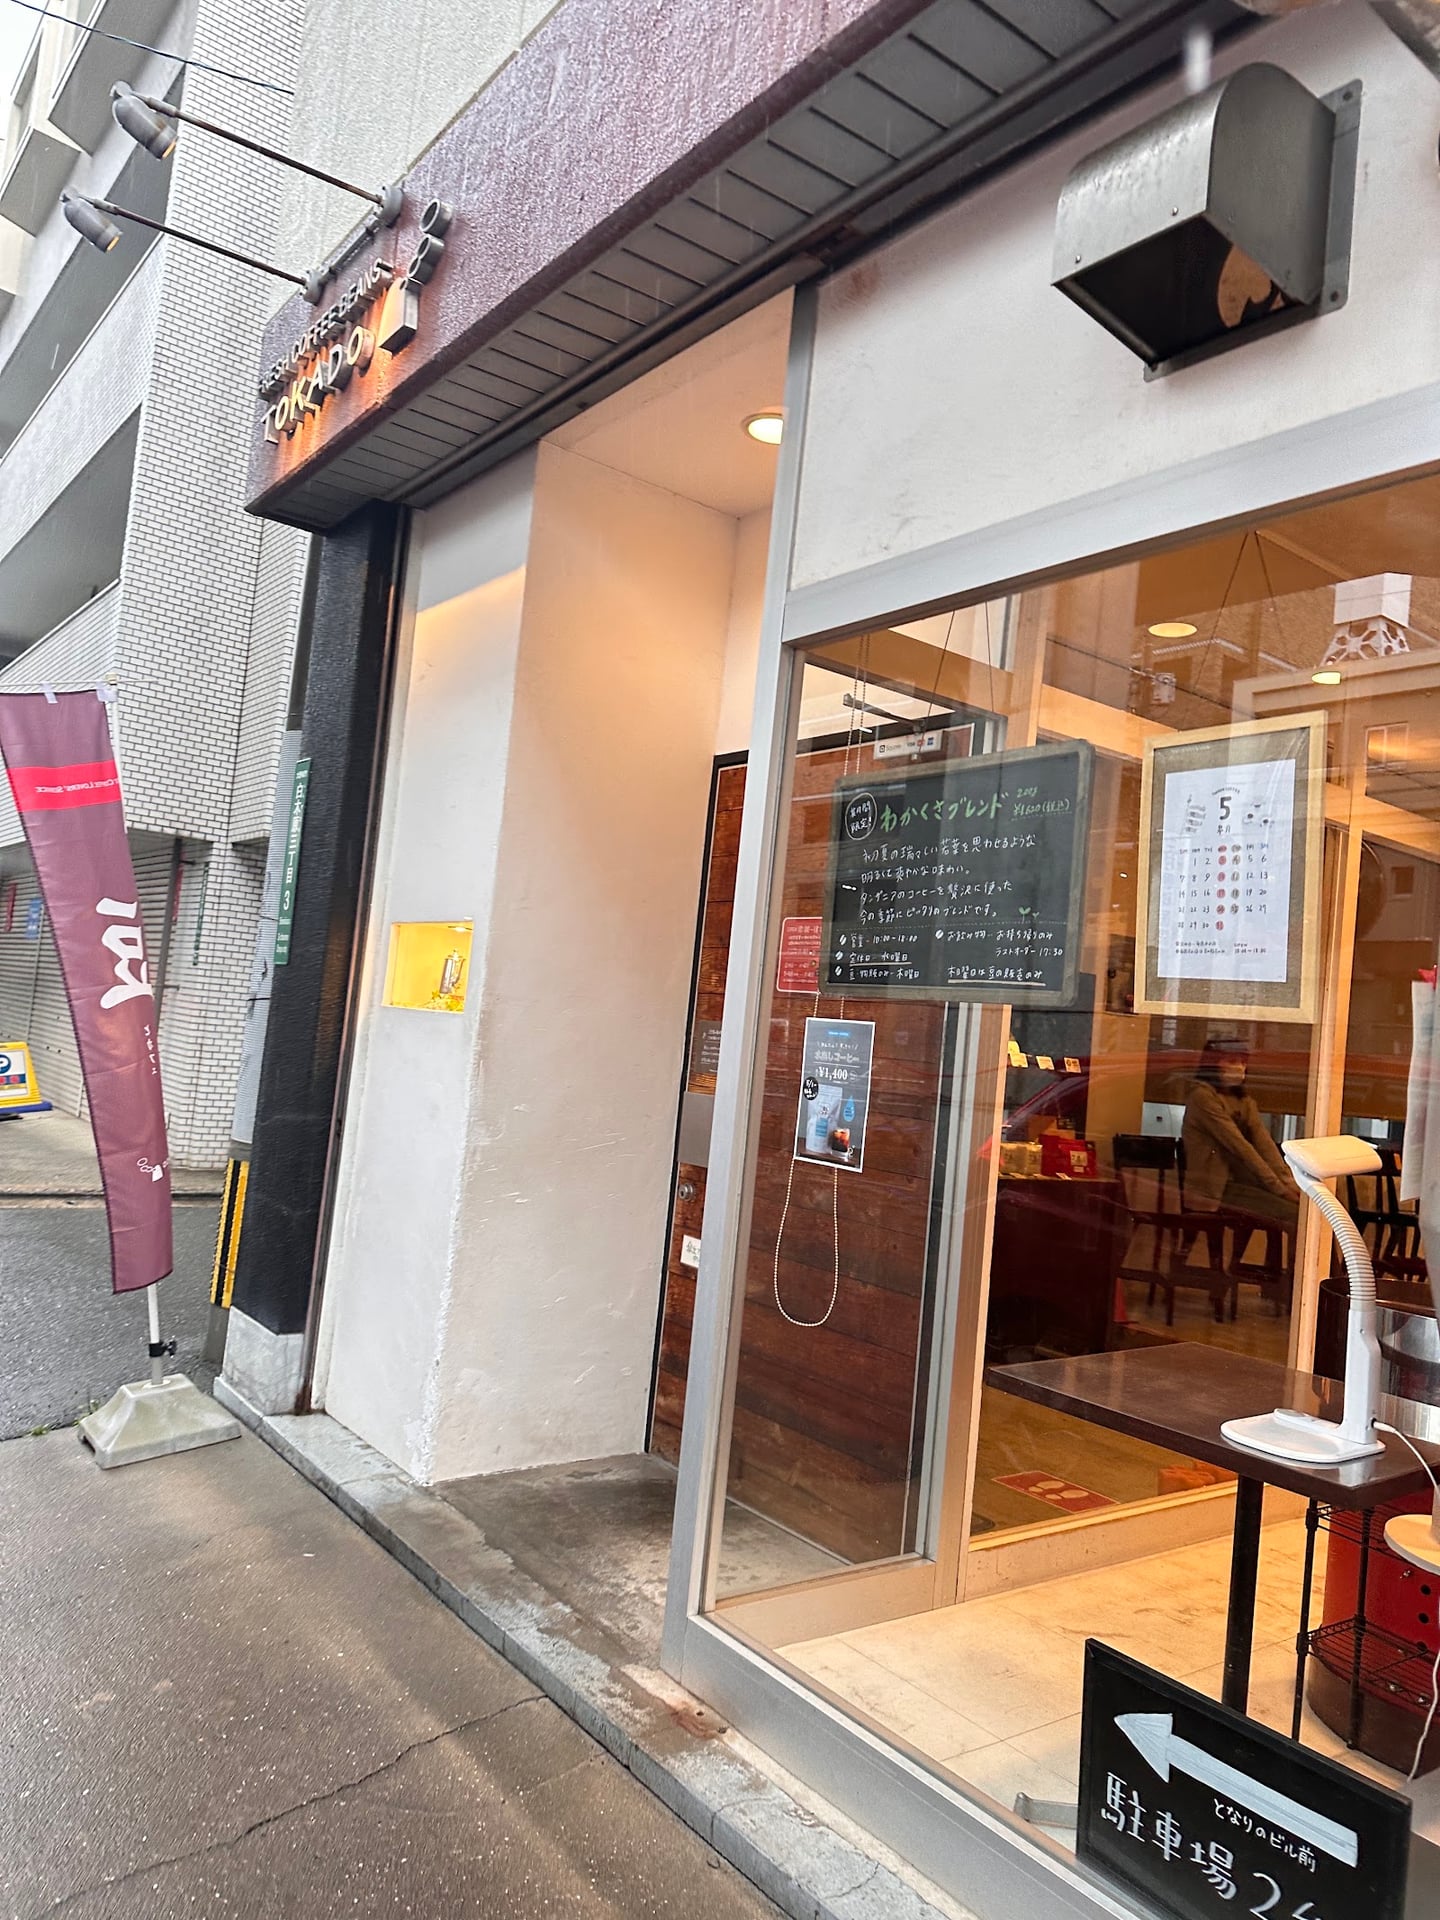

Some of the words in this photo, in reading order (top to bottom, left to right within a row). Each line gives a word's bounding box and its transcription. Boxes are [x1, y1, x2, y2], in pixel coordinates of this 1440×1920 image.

[291, 304, 337, 364] COFFEE
[338, 257, 384, 318] BEANS
[261, 326, 366, 438] TOKADO
[880, 792, 1009, 833] わかくさブレンド
[1219, 796, 1232, 820] 5
[1261, 854, 1267, 862] 6
[1204, 873, 1211, 882] 9
[1246, 871, 1254, 880] 12
[1260, 871, 1268, 879] 13
[283, 890, 290, 911] 3
[1203, 889, 1210, 897] 16
[819, 1066, 848, 1081] ¥1,400
[1212, 1797, 1317, 1874] となりのビル前
